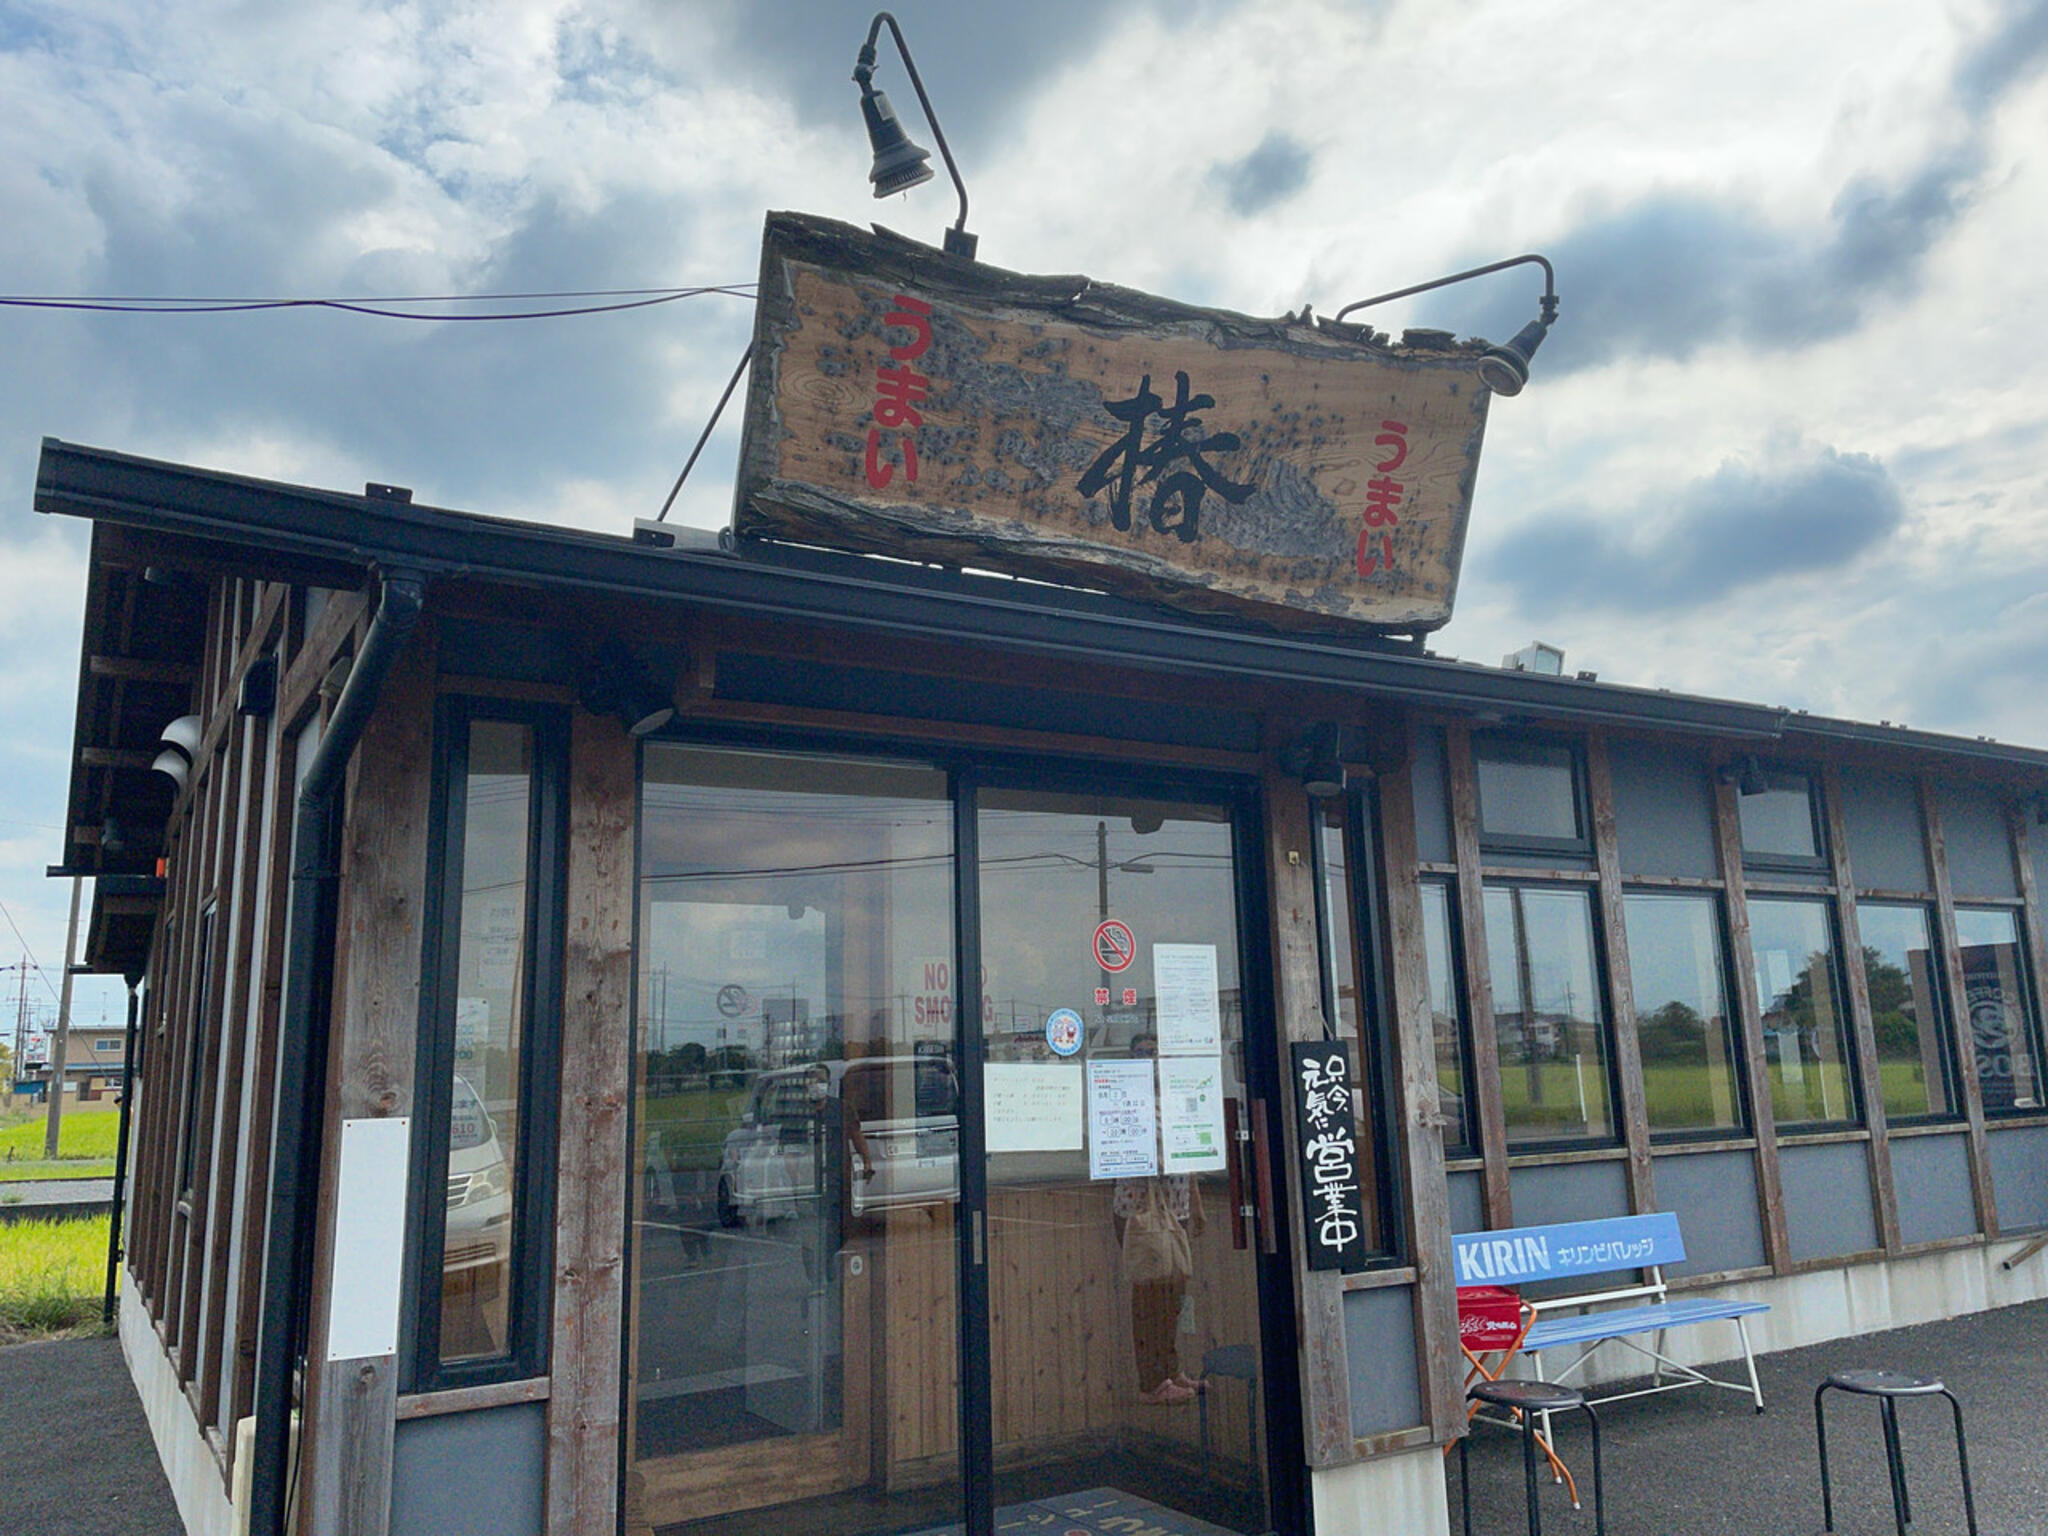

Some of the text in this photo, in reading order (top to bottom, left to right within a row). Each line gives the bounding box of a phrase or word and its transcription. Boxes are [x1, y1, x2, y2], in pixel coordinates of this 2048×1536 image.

[865, 294, 932, 489] うまい
[1076, 371, 1257, 543] 椿
[1357, 420, 1408, 577] うまい
[1302, 1058, 1335, 1129] 元気に
[1306, 1126, 1358, 1252] 営業中
[1458, 1235, 1551, 1281] KIRIN
